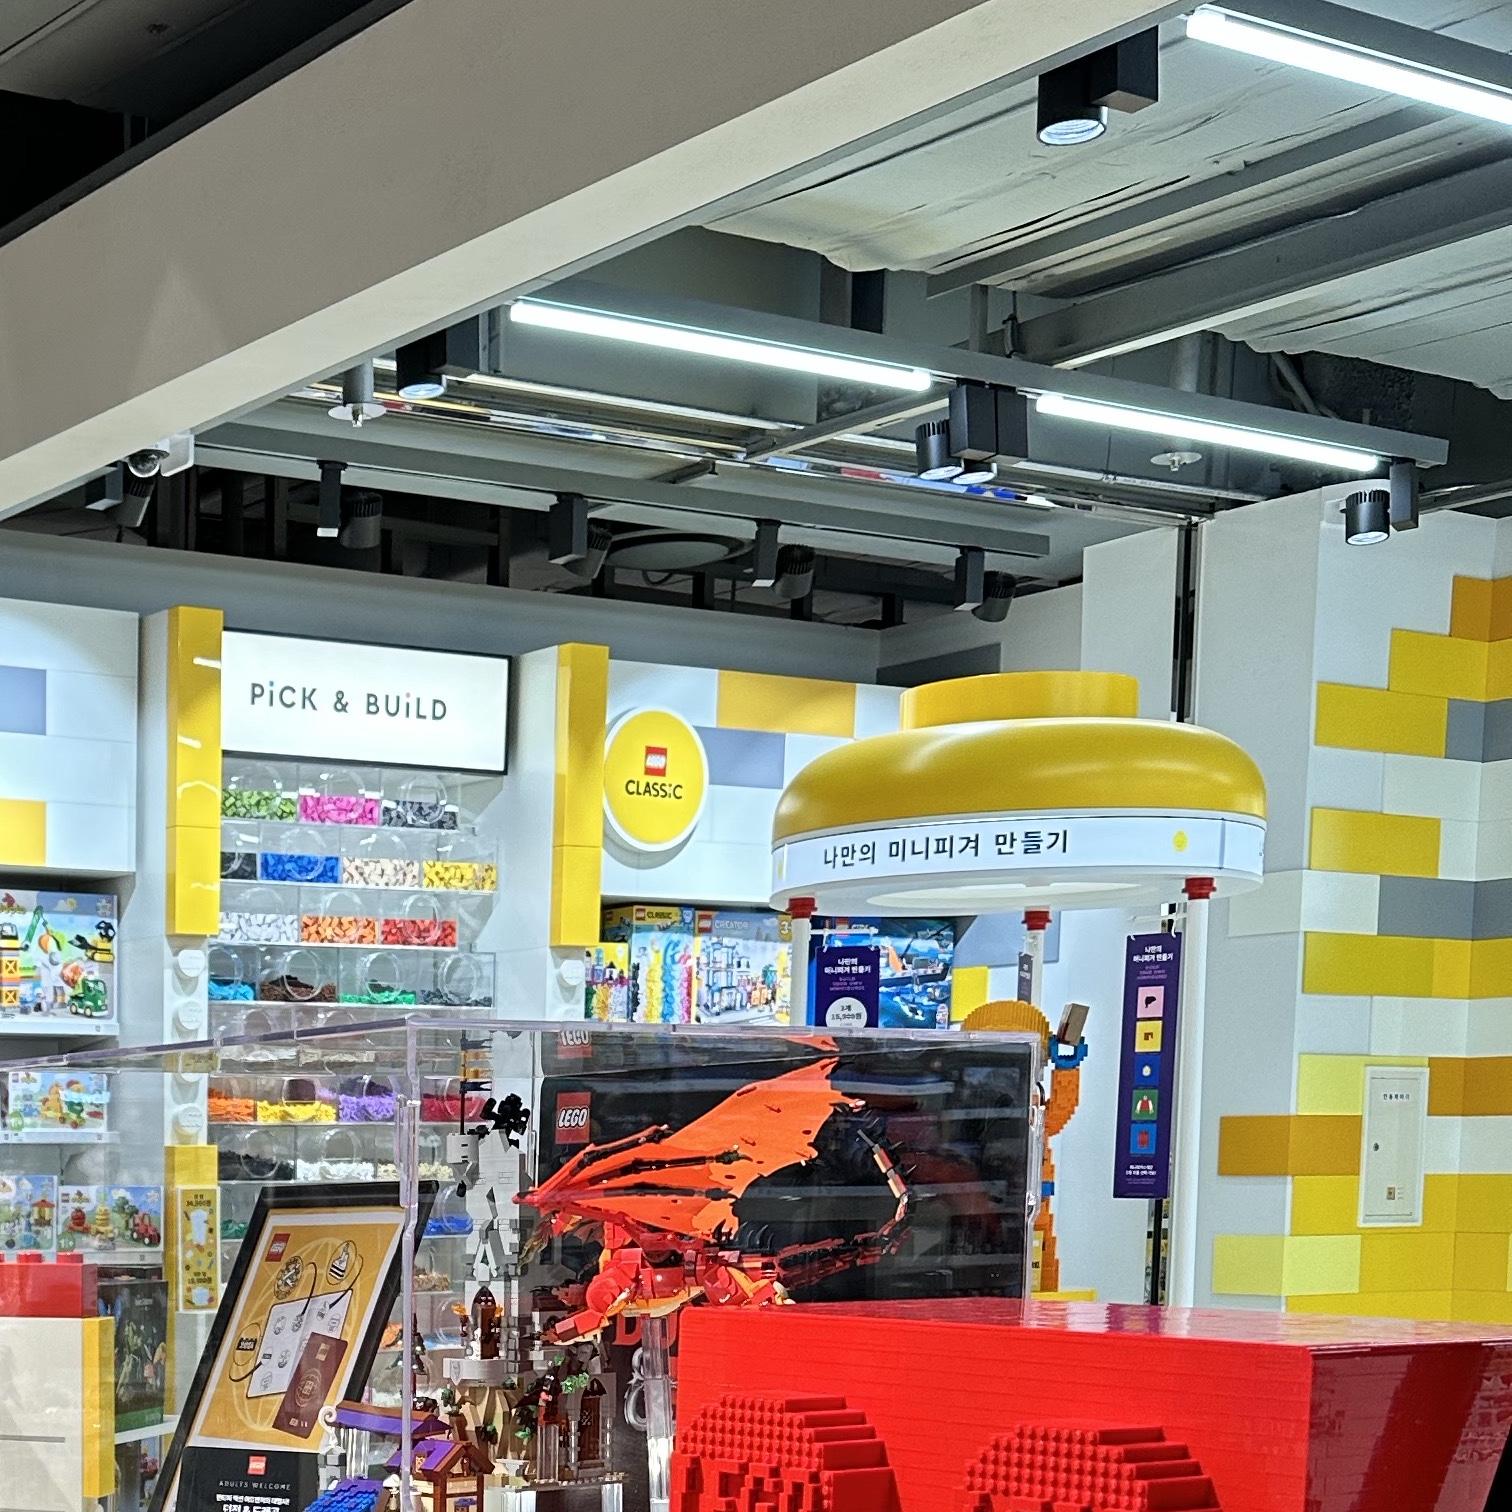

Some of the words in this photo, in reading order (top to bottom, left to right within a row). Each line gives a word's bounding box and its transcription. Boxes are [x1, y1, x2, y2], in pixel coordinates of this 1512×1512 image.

[333, 690, 349, 713] &
[823, 843, 877, 869] 나만의
[888, 833, 981, 863] 미니피겨
[994, 830, 1069, 856] 만들기
[557, 1107, 589, 1129] LEGO
[218, 1481, 248, 1489] ADULTS
[252, 1482, 290, 1491] WELCOME
